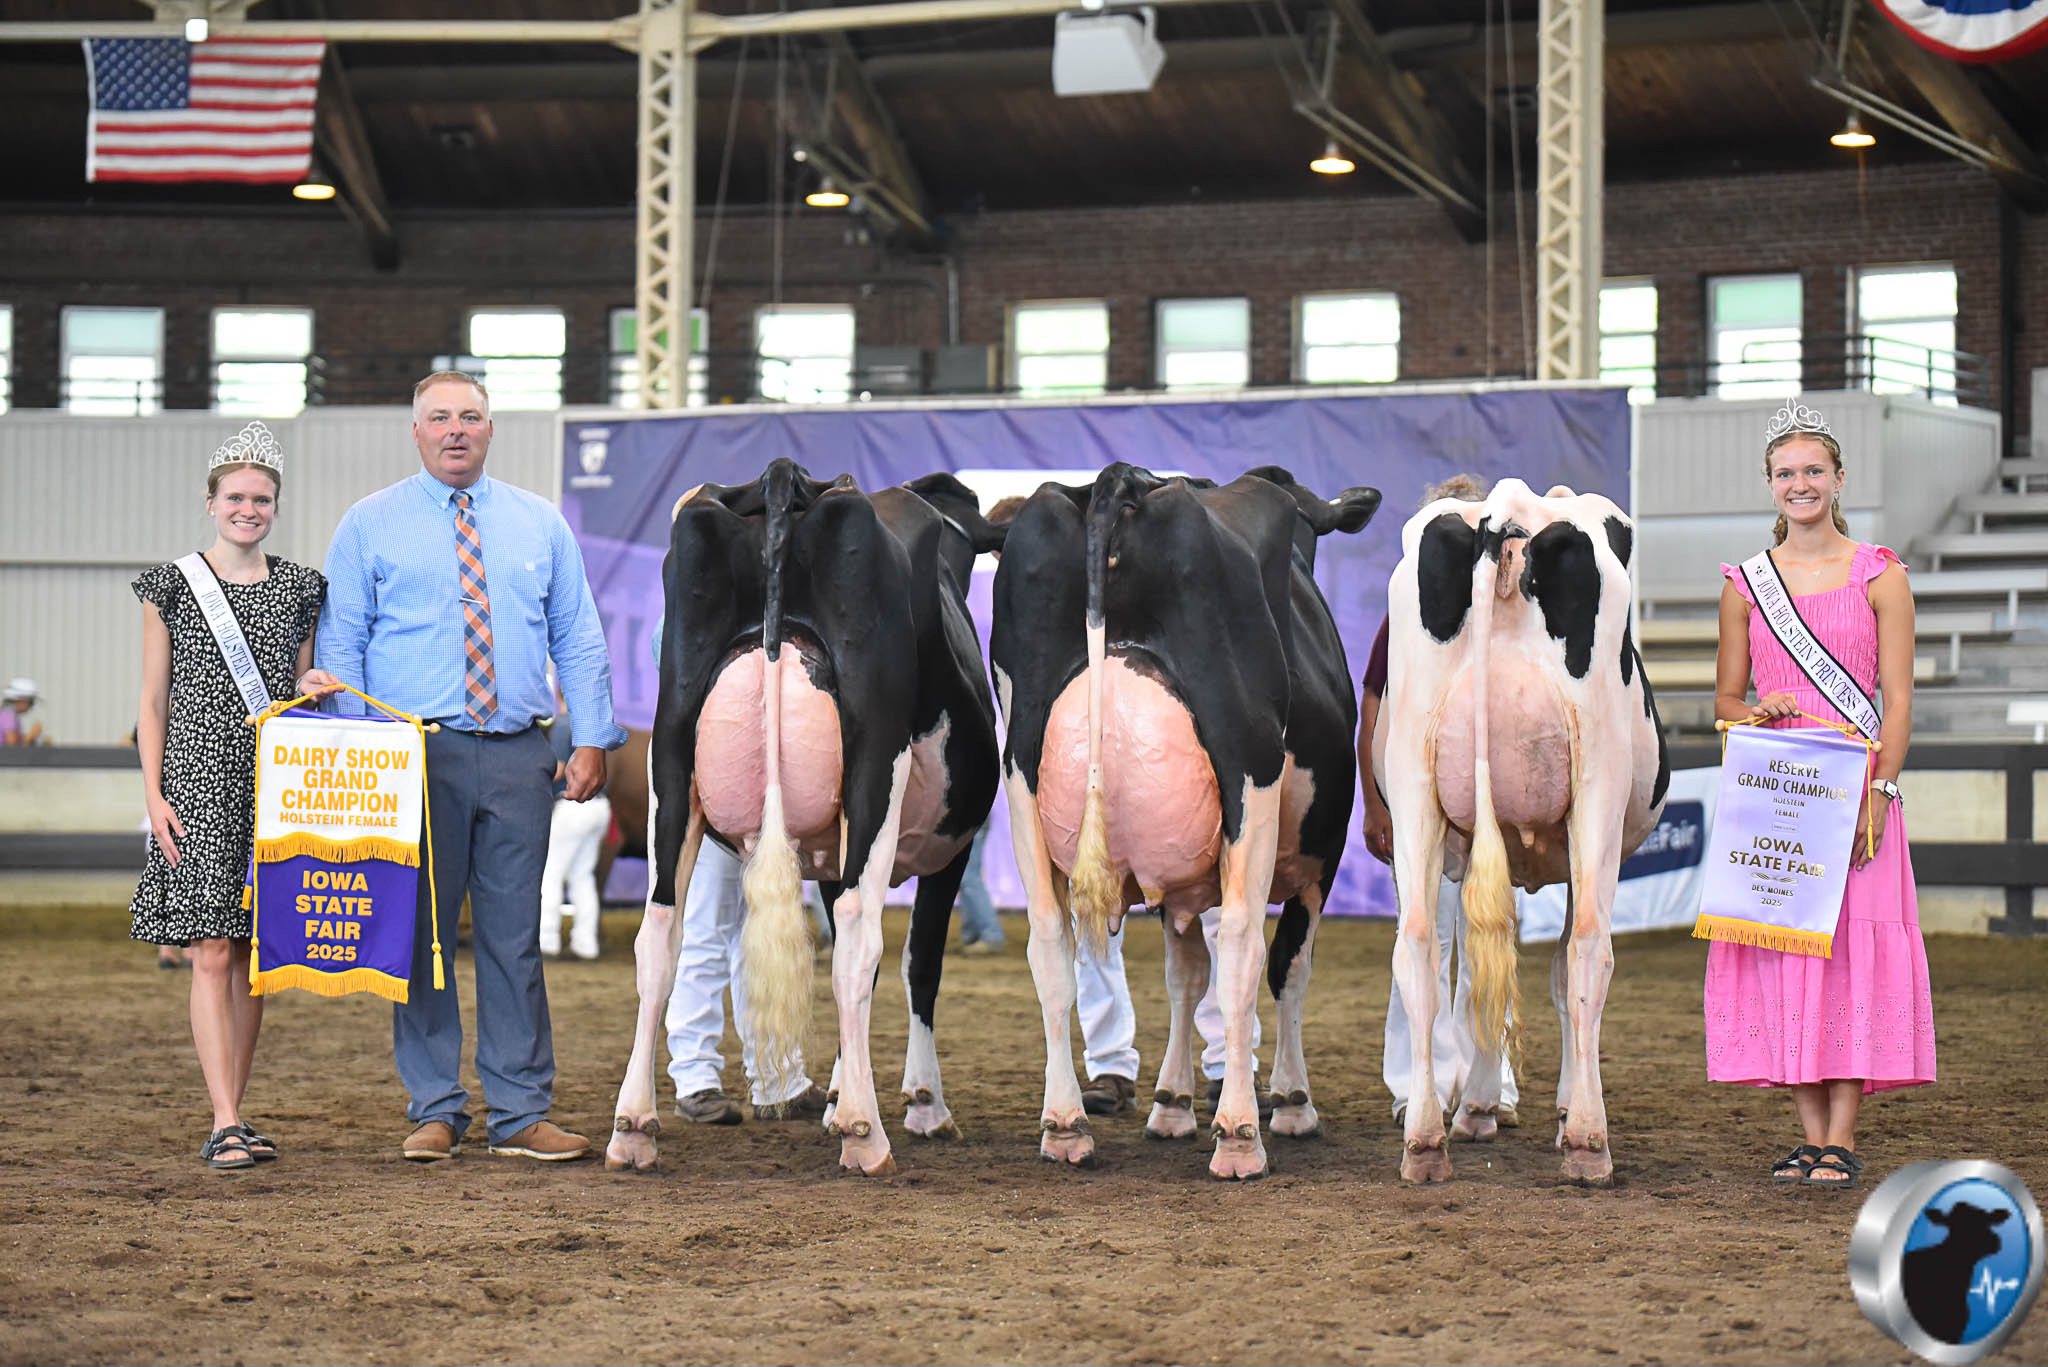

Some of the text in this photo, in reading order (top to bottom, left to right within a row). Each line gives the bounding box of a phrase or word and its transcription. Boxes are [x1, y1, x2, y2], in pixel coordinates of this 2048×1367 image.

[201, 590, 226, 622] IOWA
[216, 620, 254, 680] HOLSTEIN
[1757, 578, 1782, 610] IOWA
[1771, 605, 1817, 662] HOLSTEIN
[1810, 657, 1861, 711] PRINCESS
[273, 745, 410, 770] DAIRY SHOW
[1769, 759, 1820, 779] RESERVE
[303, 769, 378, 790] GRAND
[1738, 773, 1779, 791] GRAND
[281, 789, 398, 813] CHAMPION
[1772, 796, 1805, 807] HOLSTEIN
[280, 812, 398, 827] HOLSTEIN FEMALE
[1753, 836, 1804, 856] IOWA
[1729, 850, 1826, 877] STATE FAIR
[302, 870, 369, 892] IOWA
[1752, 884, 1794, 897] DES MOINES
[295, 894, 373, 916] STATE
[1761, 897, 1782, 907] 2025
[305, 920, 361, 940] FAIR
[306, 943, 357, 962] 2025
